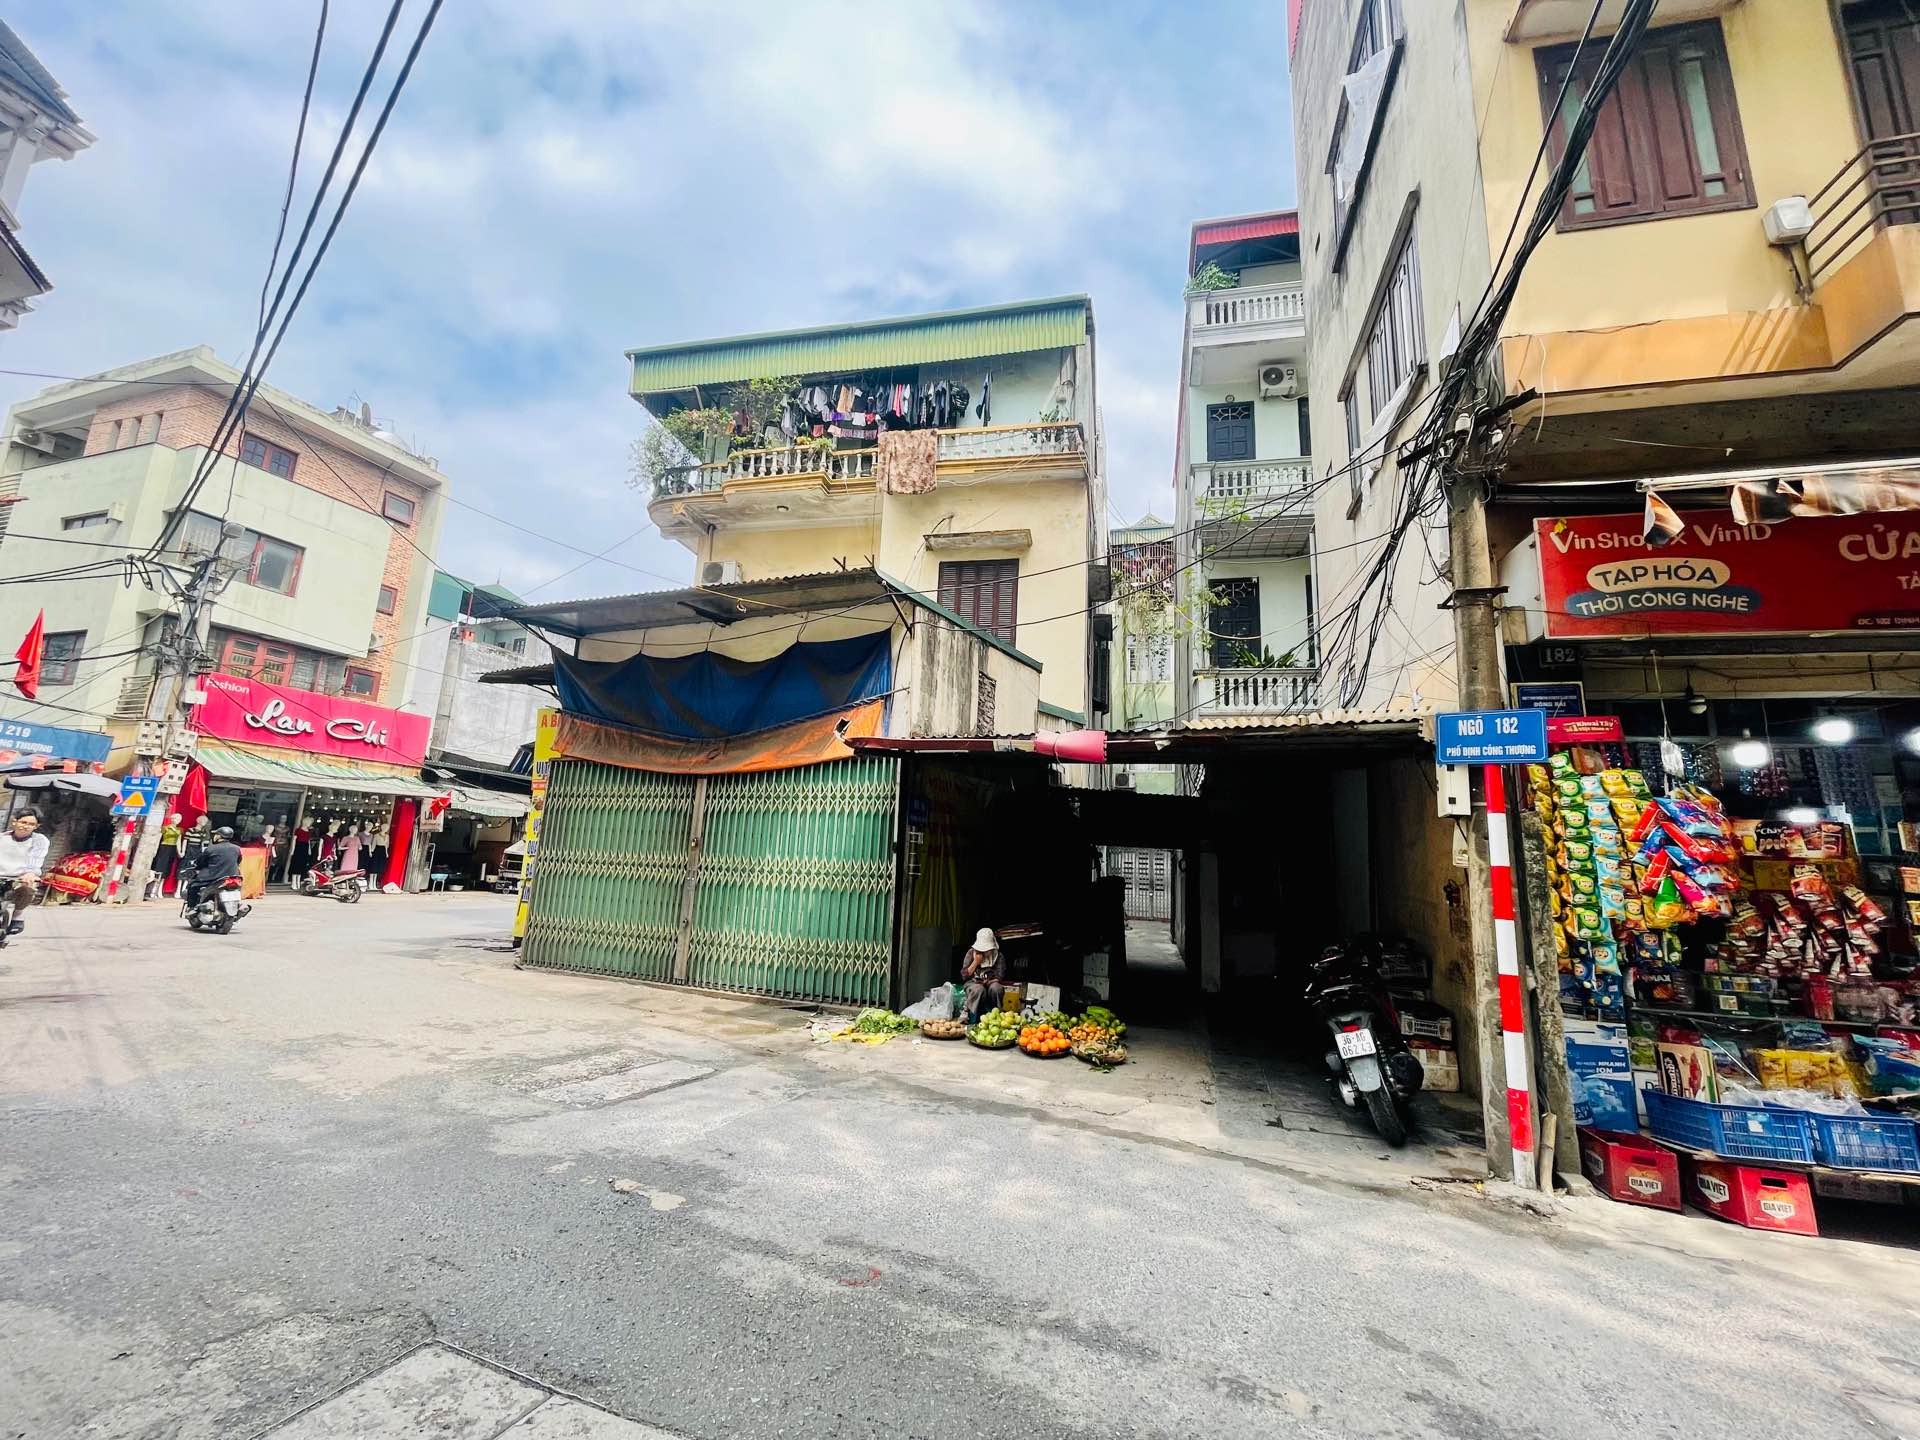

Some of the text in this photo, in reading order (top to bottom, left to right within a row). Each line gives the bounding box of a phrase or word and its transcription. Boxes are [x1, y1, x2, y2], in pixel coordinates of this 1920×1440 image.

[1692, 523, 1772, 546] VinID
[1653, 560, 1718, 584] HÓA
[1628, 591, 1687, 608] CÔNG
[1545, 648, 1576, 662] 182
[206, 678, 250, 694] Fashion
[5, 725, 32, 738] 219
[245, 700, 388, 747] Lan Chi
[1458, 715, 1519, 736] NGÕ 182
[1446, 744, 1461, 757] PHỐ
[1482, 744, 1504, 757] CÔNG
